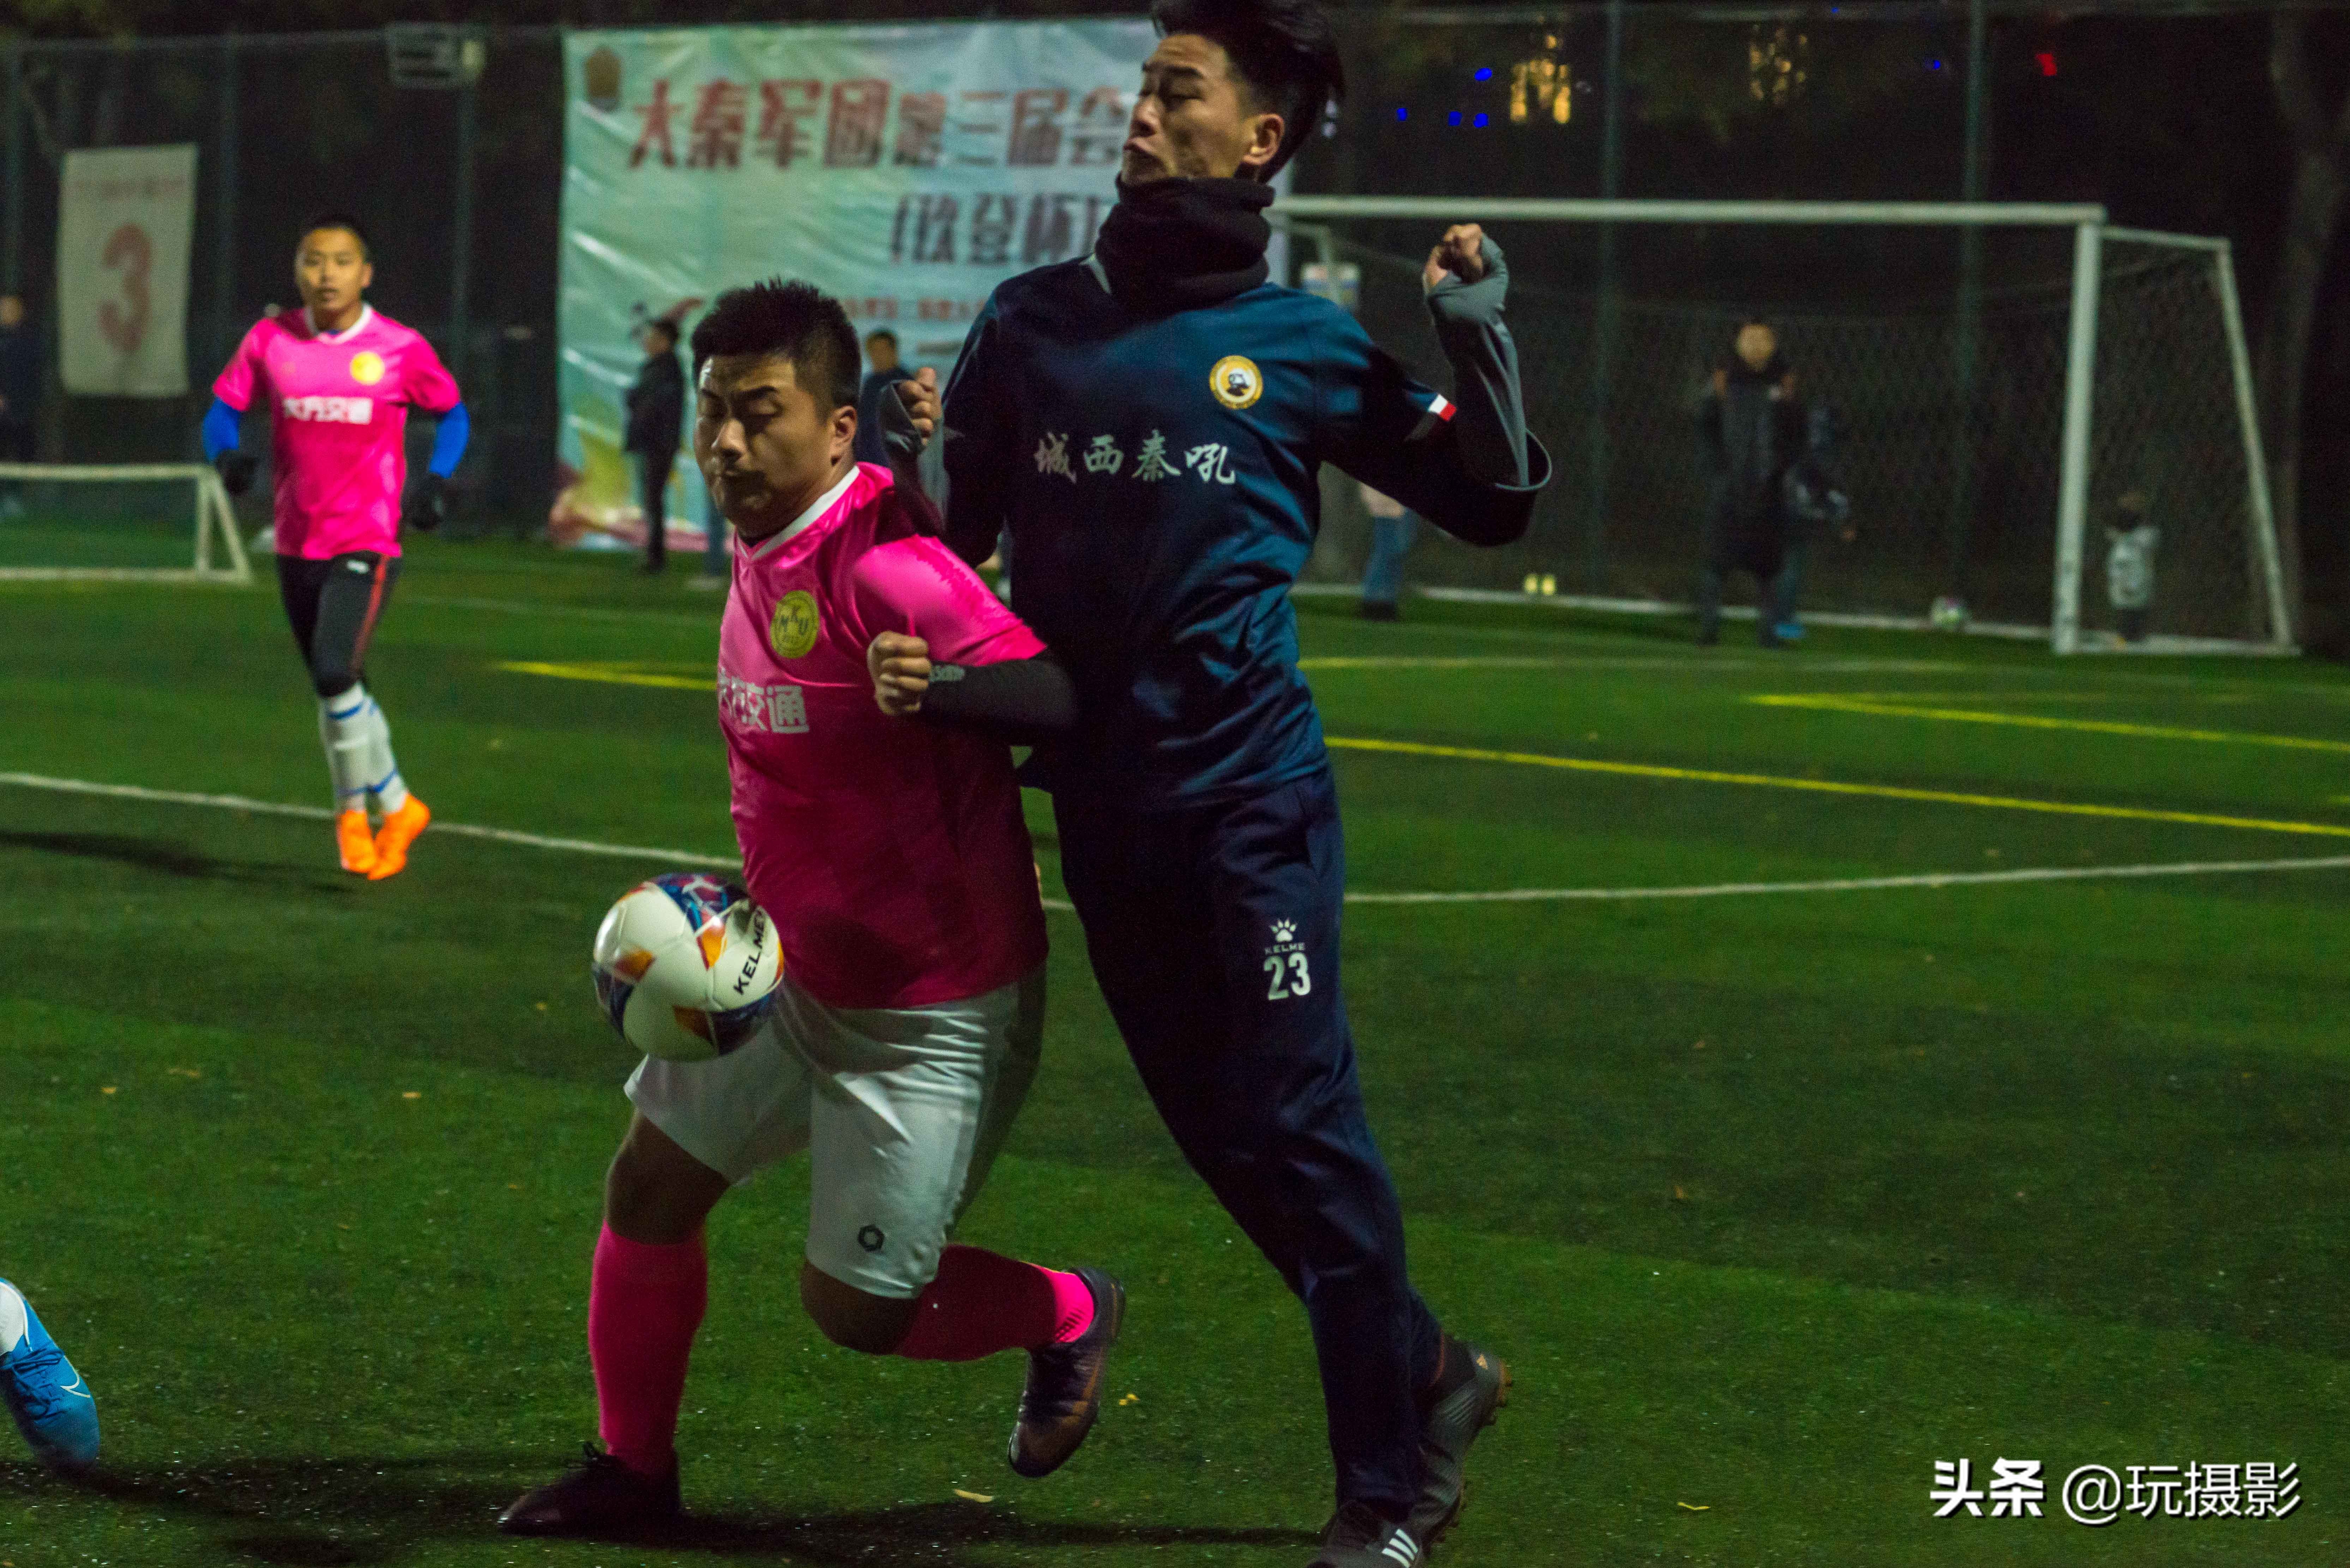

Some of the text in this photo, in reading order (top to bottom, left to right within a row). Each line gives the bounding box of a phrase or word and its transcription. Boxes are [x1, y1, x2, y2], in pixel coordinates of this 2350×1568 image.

[98, 222, 153, 351] 3
[1034, 429, 1235, 485] 城西秦吼
[733, 916, 765, 995] KELME
[1264, 952, 1311, 1000] 23
